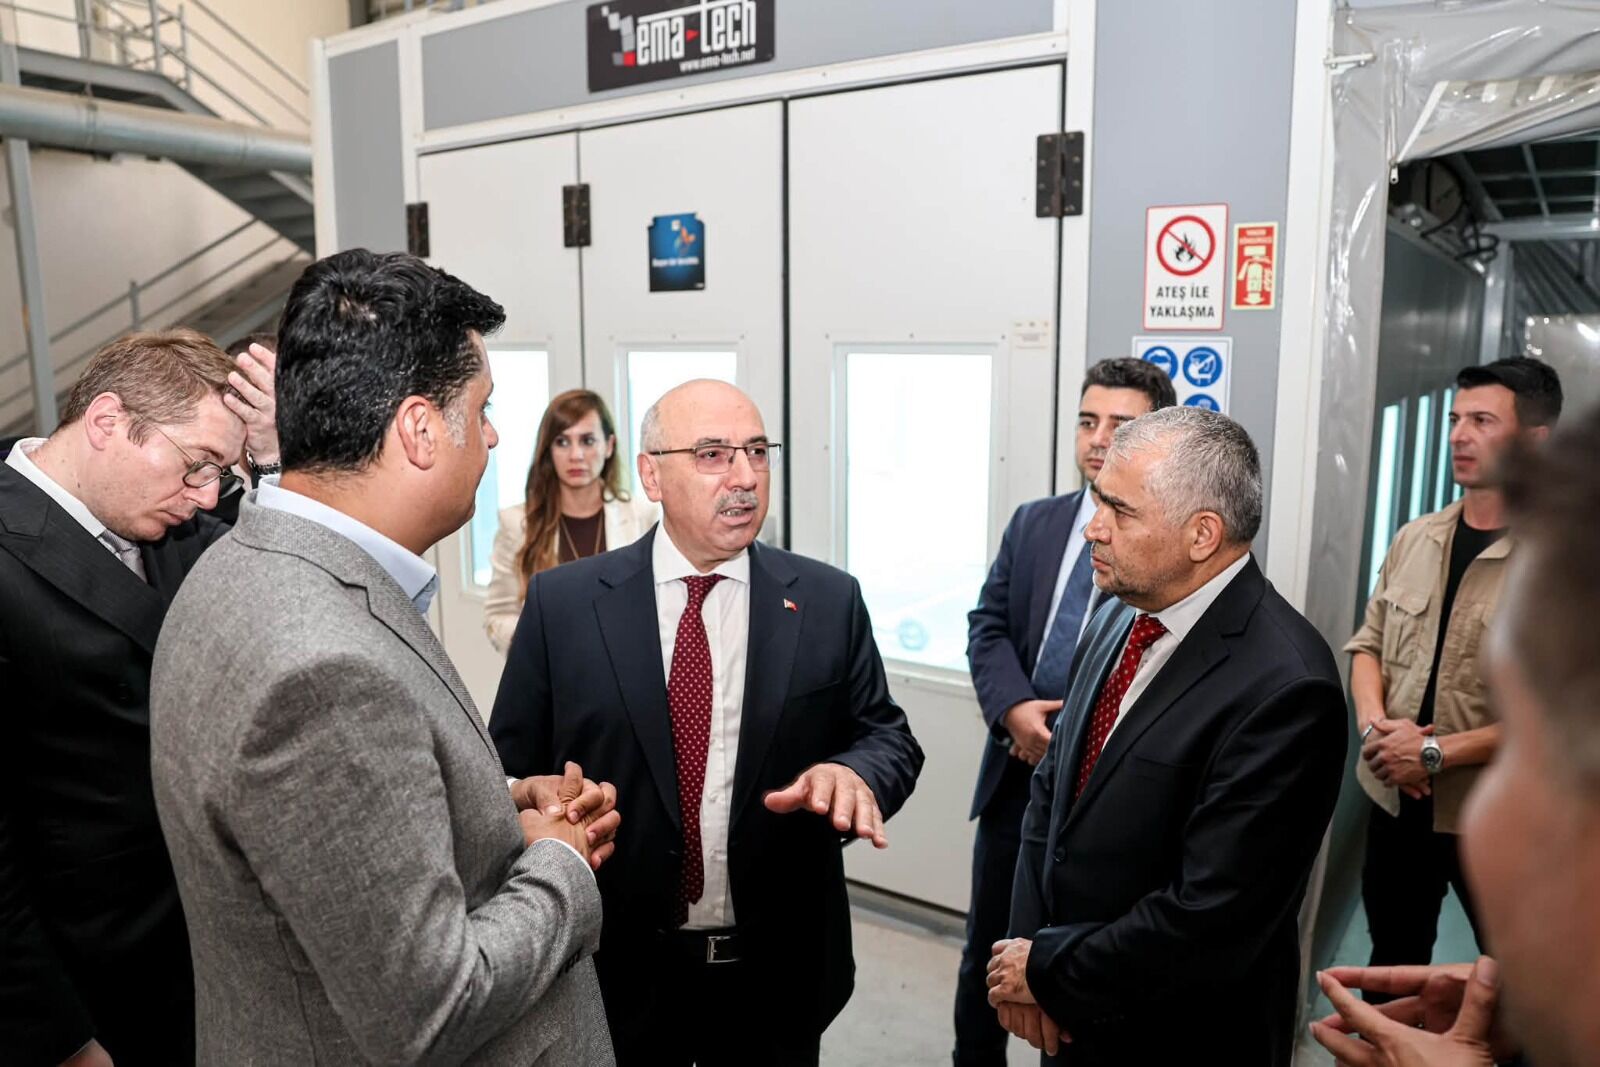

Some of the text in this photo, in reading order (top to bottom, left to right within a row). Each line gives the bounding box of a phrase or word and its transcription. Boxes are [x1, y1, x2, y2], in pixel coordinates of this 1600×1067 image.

[1156, 282, 1209, 301] ATEŞ İLE
[1150, 305, 1215, 321] YAKLAŞMA
